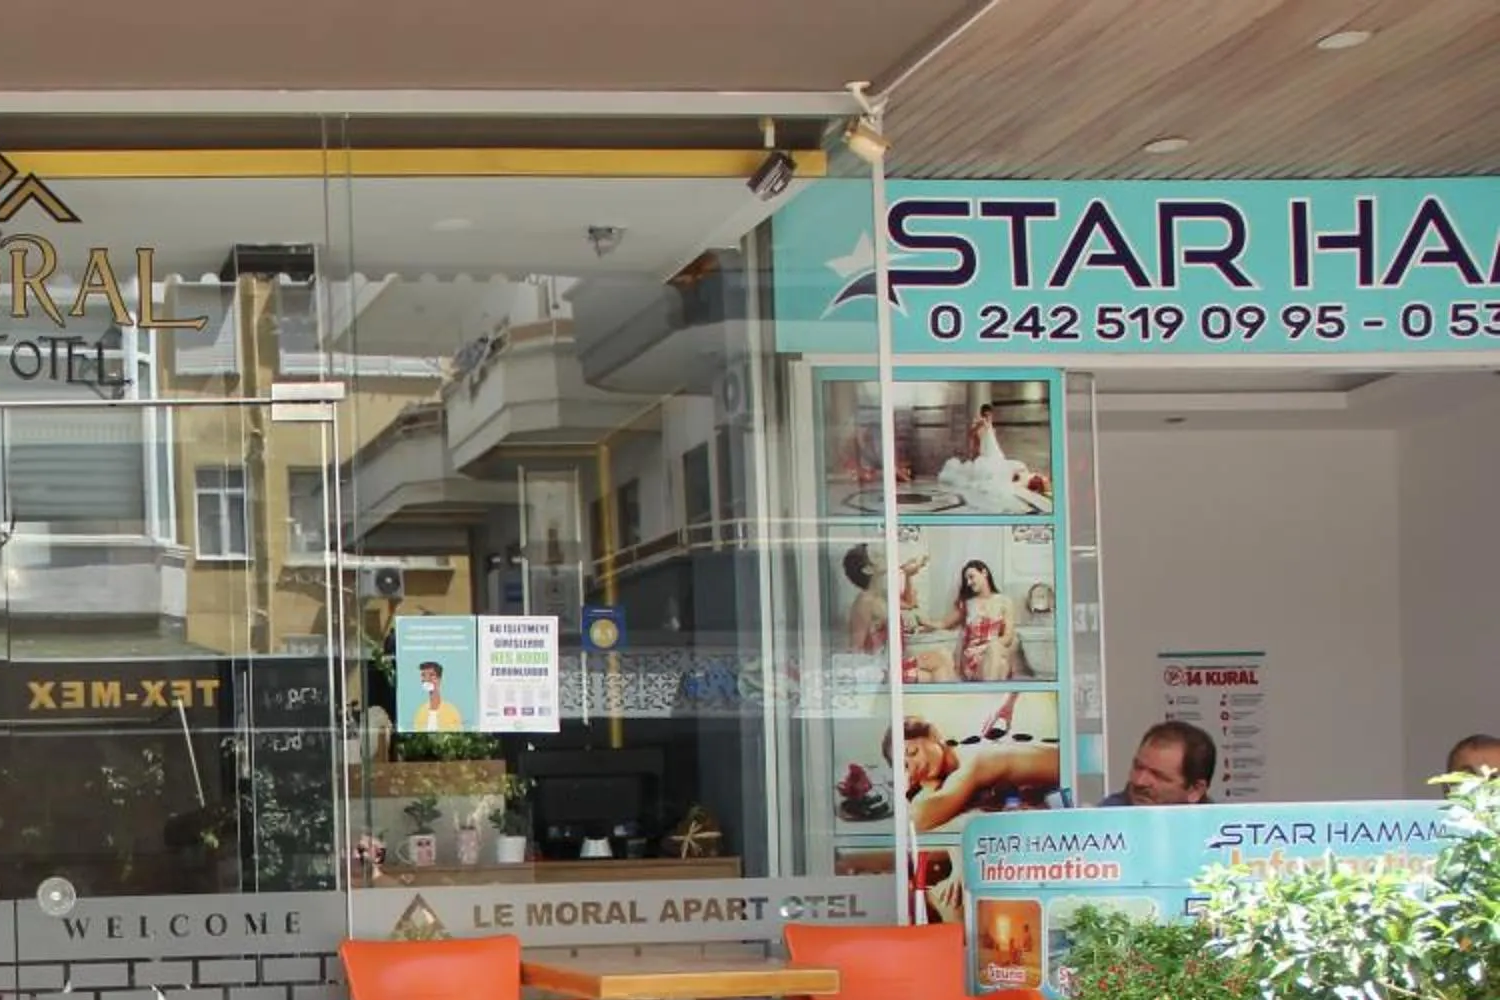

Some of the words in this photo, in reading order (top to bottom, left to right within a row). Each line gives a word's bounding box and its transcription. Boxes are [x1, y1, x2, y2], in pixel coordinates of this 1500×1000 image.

[886, 198, 1258, 290] STAR
[1290, 197, 1500, 289] HA
[930, 303, 963, 341] 0
[978, 303, 1080, 341] 242
[1095, 303, 1186, 341] 519
[1201, 303, 1268, 341] 09
[1280, 303, 1347, 341] 95
[1400, 302, 1434, 340] 0
[9, 335, 133, 387] OTEL
[1205, 670, 1259, 686] KURAL
[975, 835, 1021, 856] STAR
[1026, 831, 1128, 853] HAMAM
[1208, 822, 1316, 849] STAR
[980, 856, 1120, 881] Information
[61, 911, 302, 940] WELCOME
[472, 903, 514, 928] LE
[526, 899, 648, 926] MORAL
[658, 896, 770, 922] APART
[779, 894, 868, 918] OTEL
